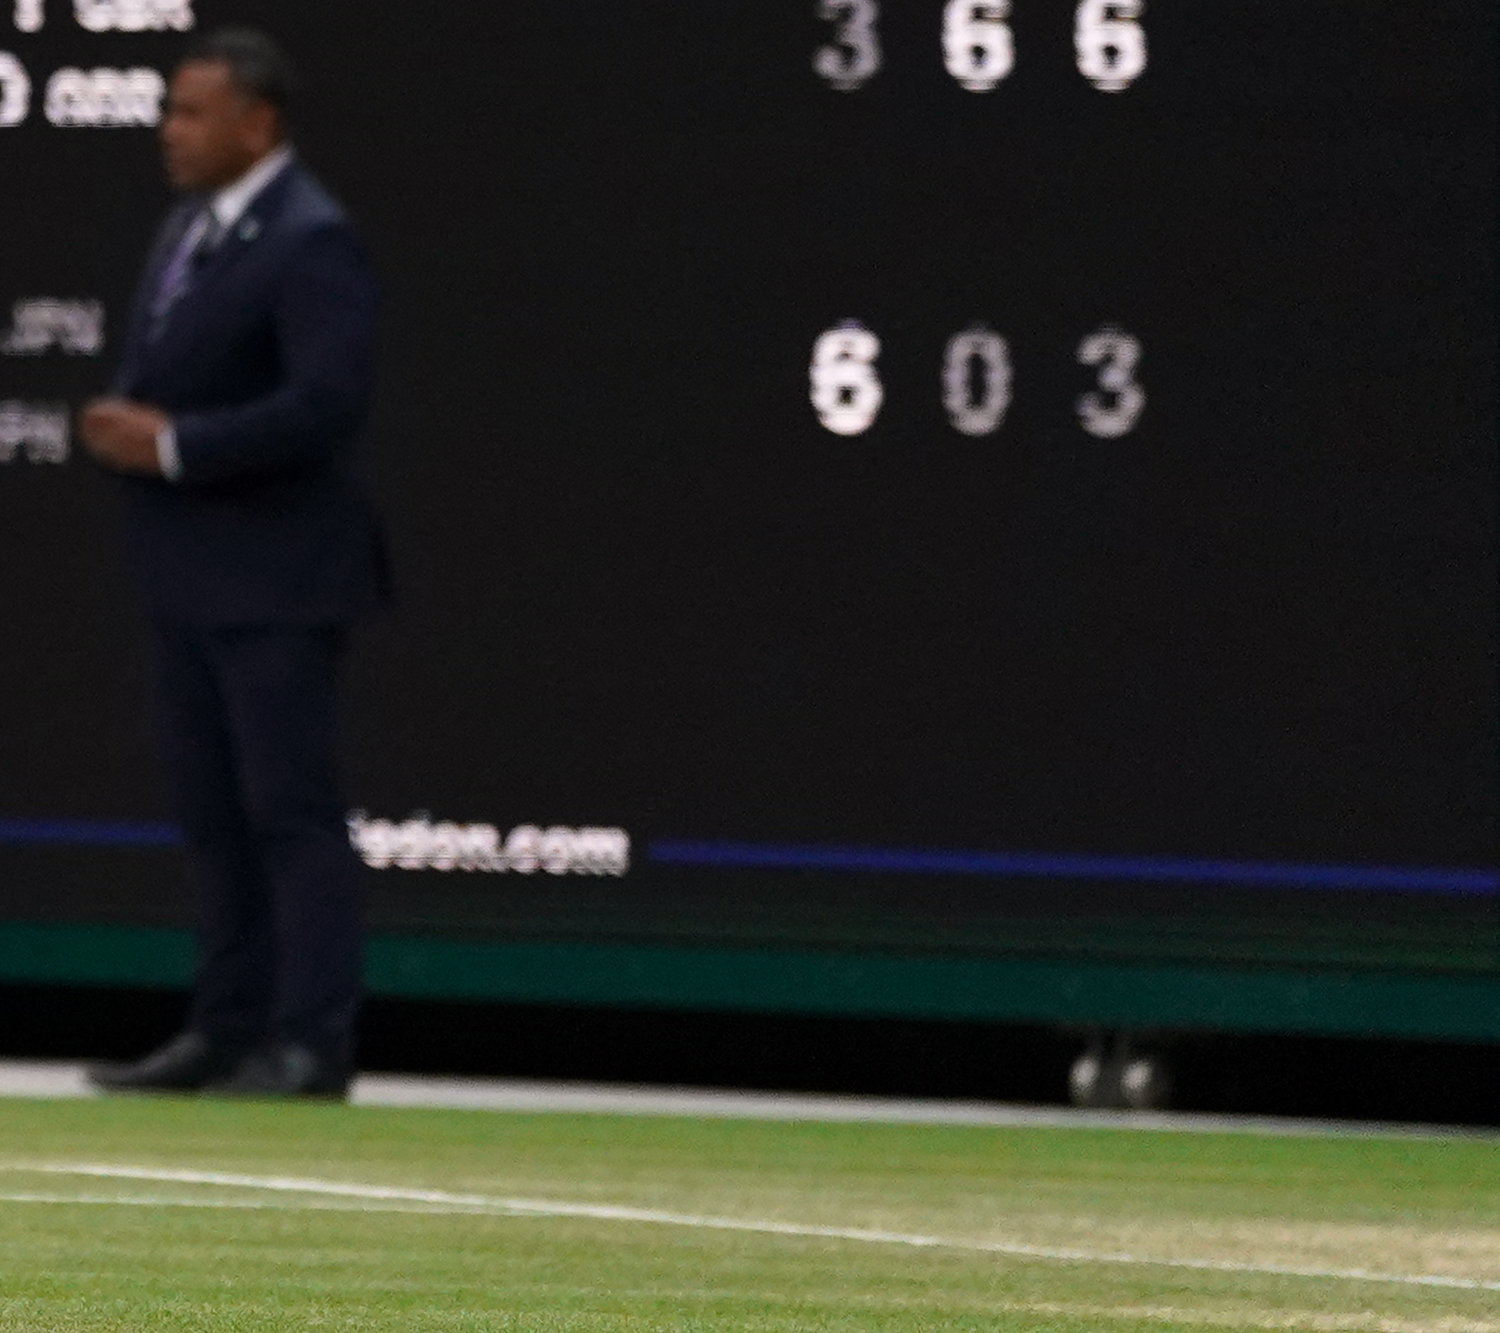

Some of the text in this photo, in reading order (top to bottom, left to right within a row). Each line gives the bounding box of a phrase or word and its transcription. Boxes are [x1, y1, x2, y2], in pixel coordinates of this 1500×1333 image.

[808, 320, 884, 437] 6
[942, 327, 1013, 439] 0
[1076, 329, 1147, 440] 3
